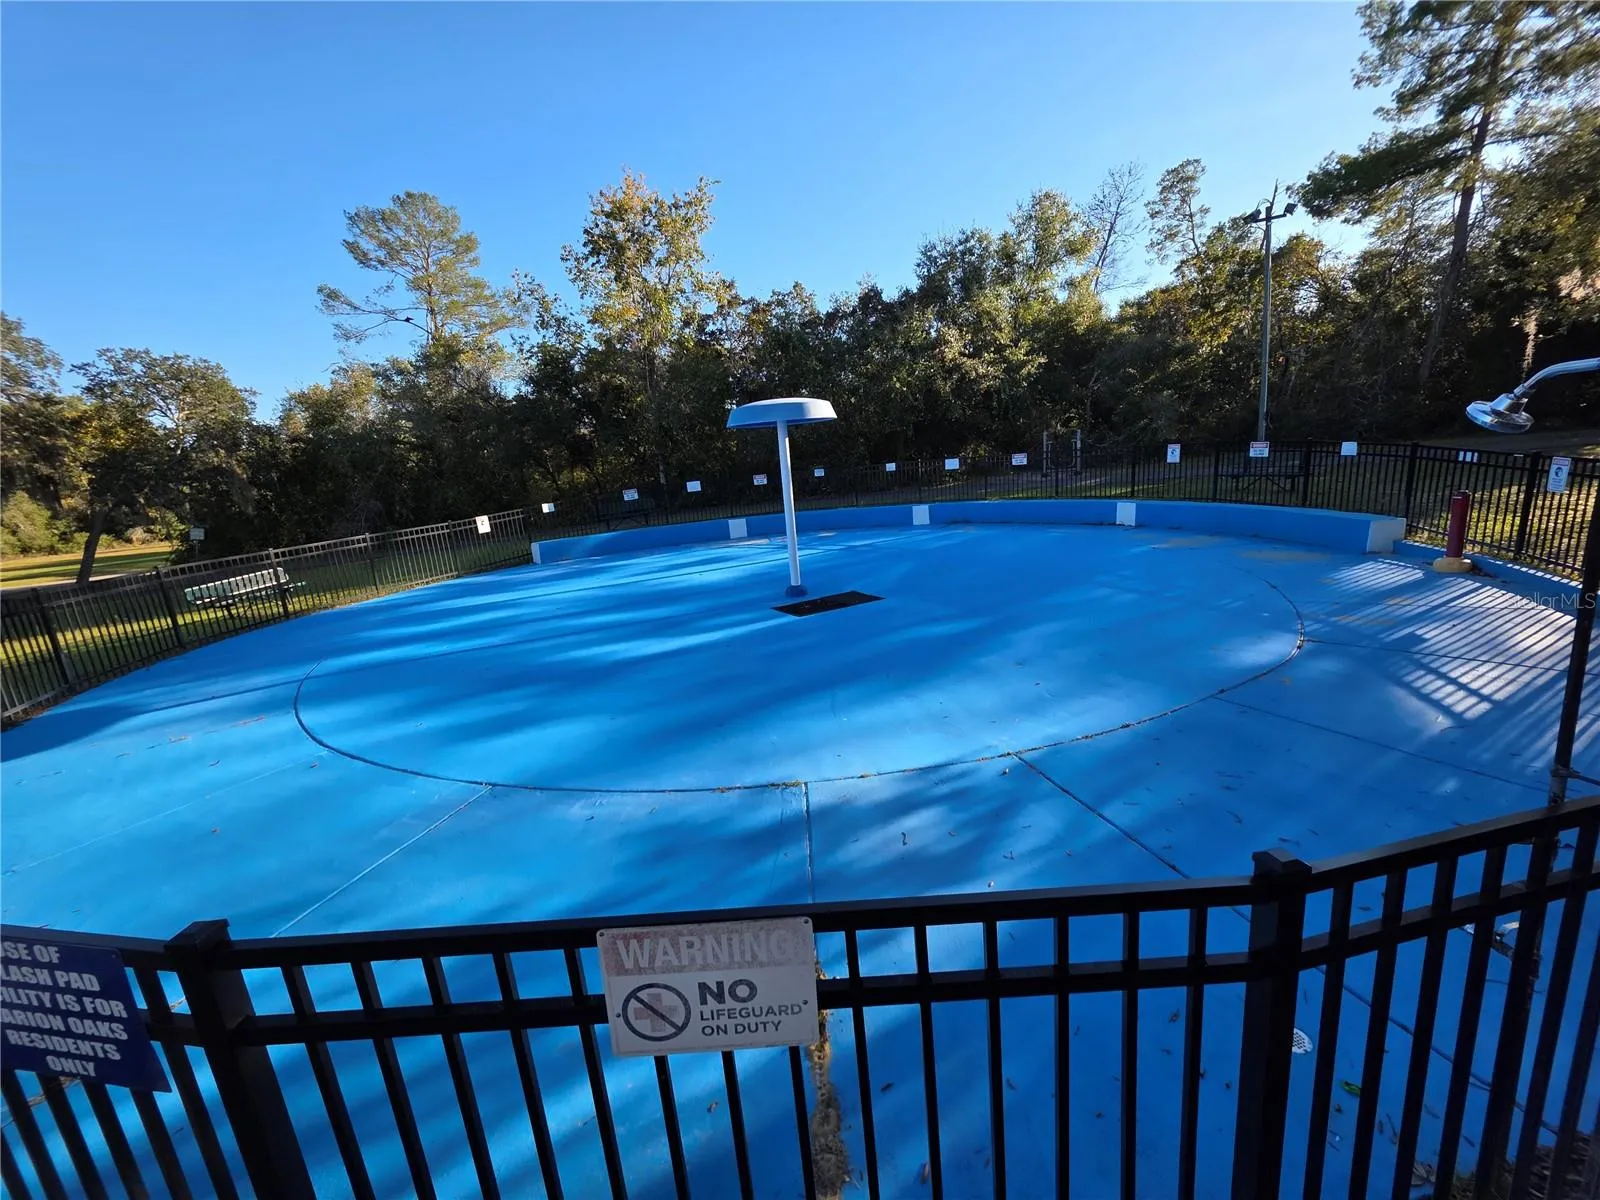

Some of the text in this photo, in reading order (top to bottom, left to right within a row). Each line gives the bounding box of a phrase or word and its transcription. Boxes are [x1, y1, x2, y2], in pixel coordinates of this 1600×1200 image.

[0, 941, 61, 963] SE OF
[616, 929, 791, 969] WARNING
[55, 970, 100, 992] PAD
[698, 979, 757, 1005] NO
[0, 986, 128, 1019] ILITY IS FOR
[700, 1003, 802, 1021] LIFEGUARD
[67, 1018, 129, 1041] OAKS
[701, 1020, 782, 1037] ON DUTY
[6, 1030, 121, 1060] RESIDENTS
[46, 1056, 96, 1077] ONLY
